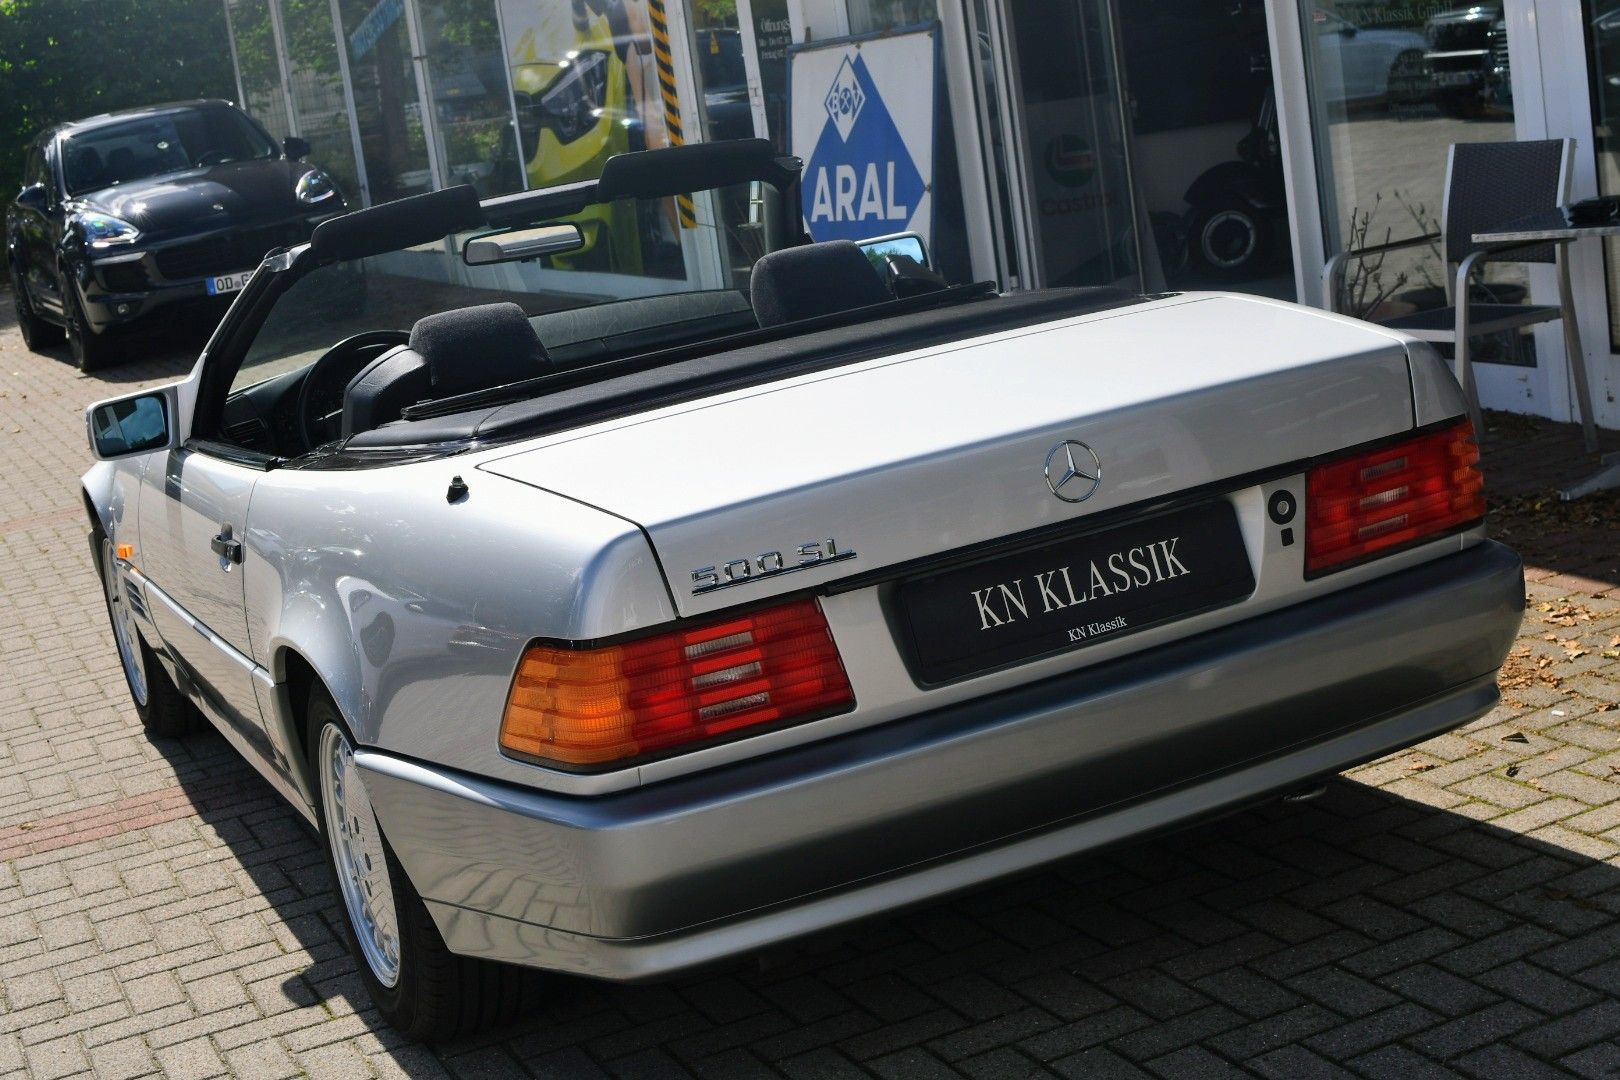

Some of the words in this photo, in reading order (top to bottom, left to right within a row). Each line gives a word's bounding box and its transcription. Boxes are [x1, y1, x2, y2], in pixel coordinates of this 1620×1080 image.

[811, 161, 907, 223] ARAL
[216, 277, 233, 291] OD
[690, 551, 783, 590] 500
[796, 538, 857, 566] SL
[971, 579, 1029, 631] KN
[1034, 537, 1191, 613] KLASSIK
[1068, 627, 1086, 642] KN
[1087, 616, 1128, 636] Klassik
